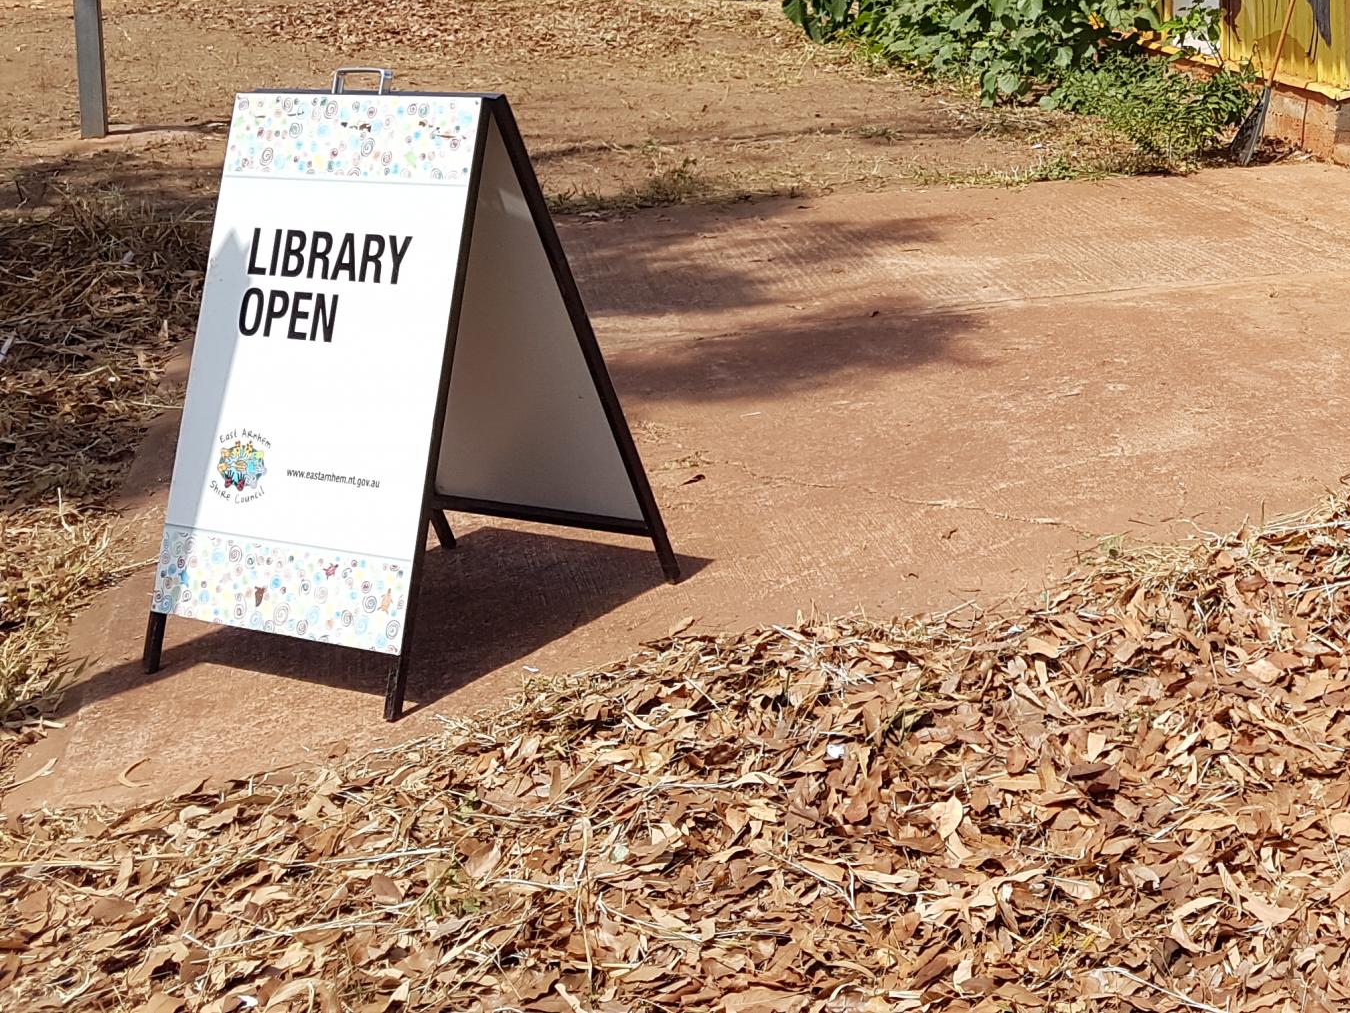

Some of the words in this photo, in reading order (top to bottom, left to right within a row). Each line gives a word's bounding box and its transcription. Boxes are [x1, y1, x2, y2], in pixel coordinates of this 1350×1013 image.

[247, 227, 413, 285] LIBRARY
[238, 287, 339, 343] OPEN
[219, 428, 237, 444] East
[286, 468, 381, 489] www.eastarnhem.nt.gov.au
[234, 485, 265, 504] Council
